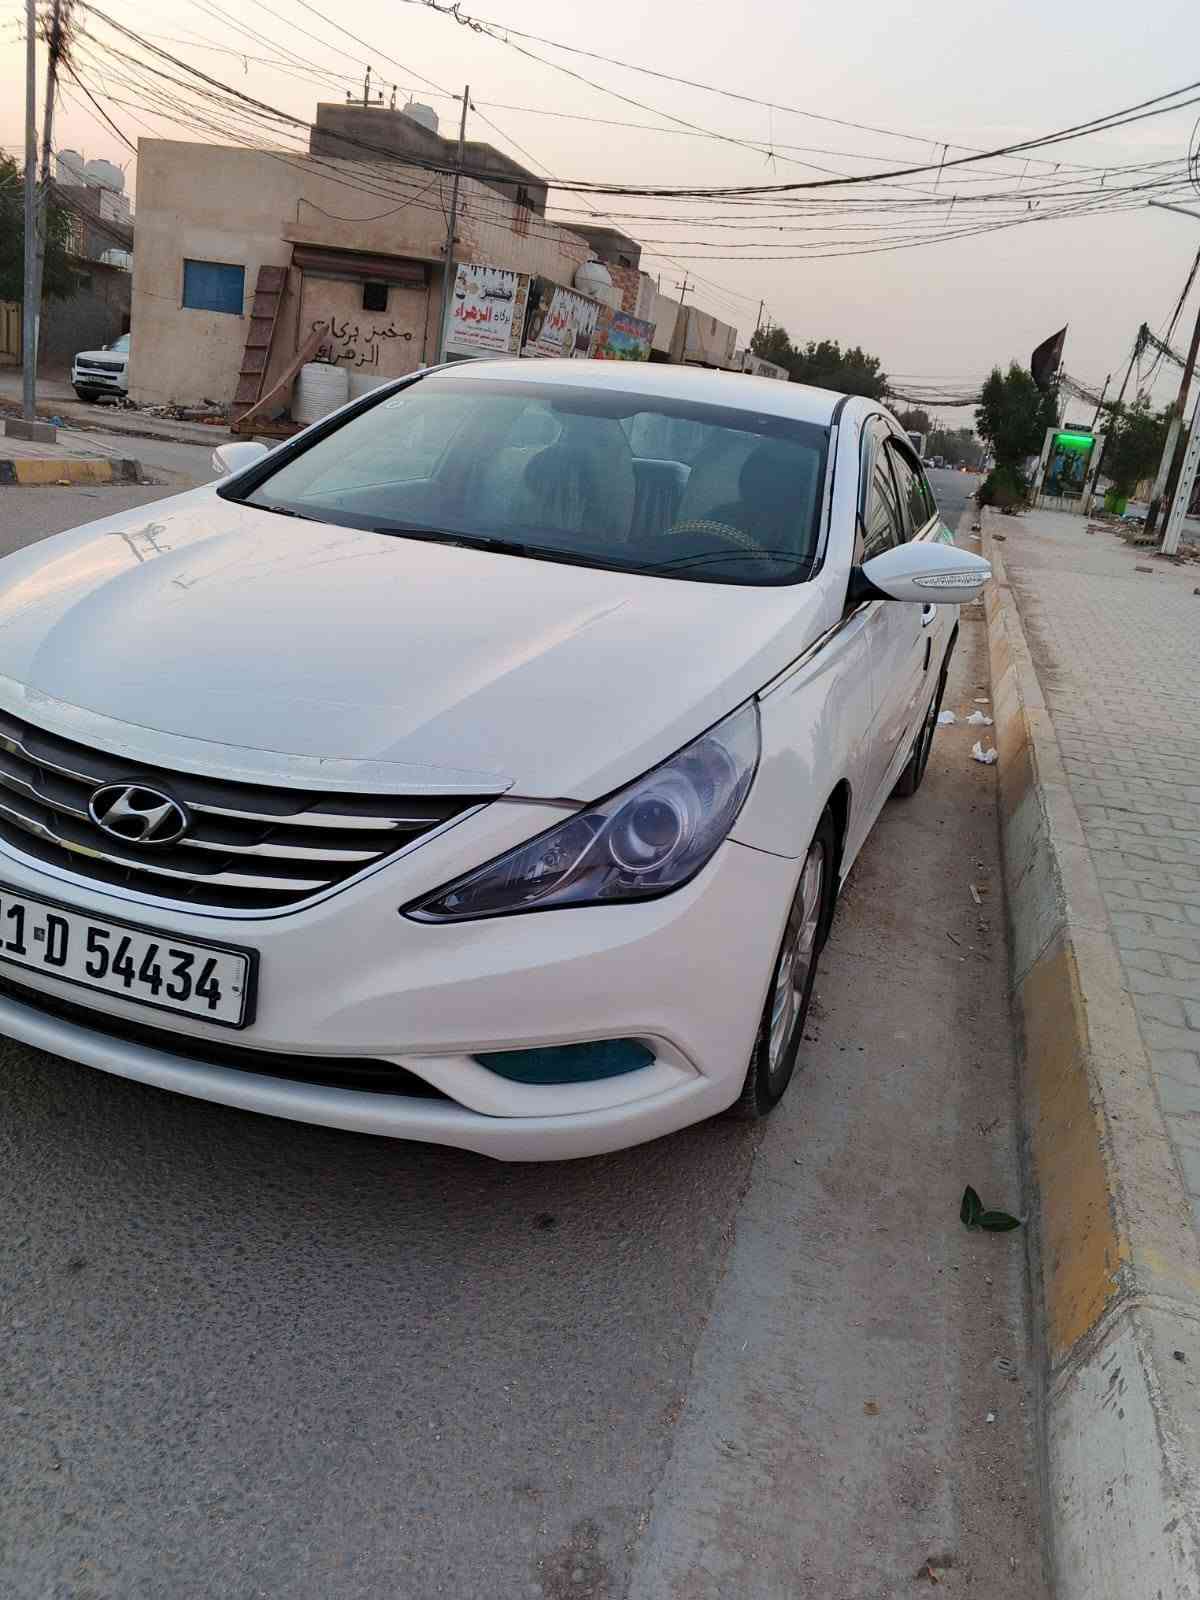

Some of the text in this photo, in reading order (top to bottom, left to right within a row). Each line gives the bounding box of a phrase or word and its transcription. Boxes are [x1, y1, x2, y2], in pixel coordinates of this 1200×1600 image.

[364, 322, 412, 343] مخبز
[0, 899, 221, 1010] 1 D 54434
